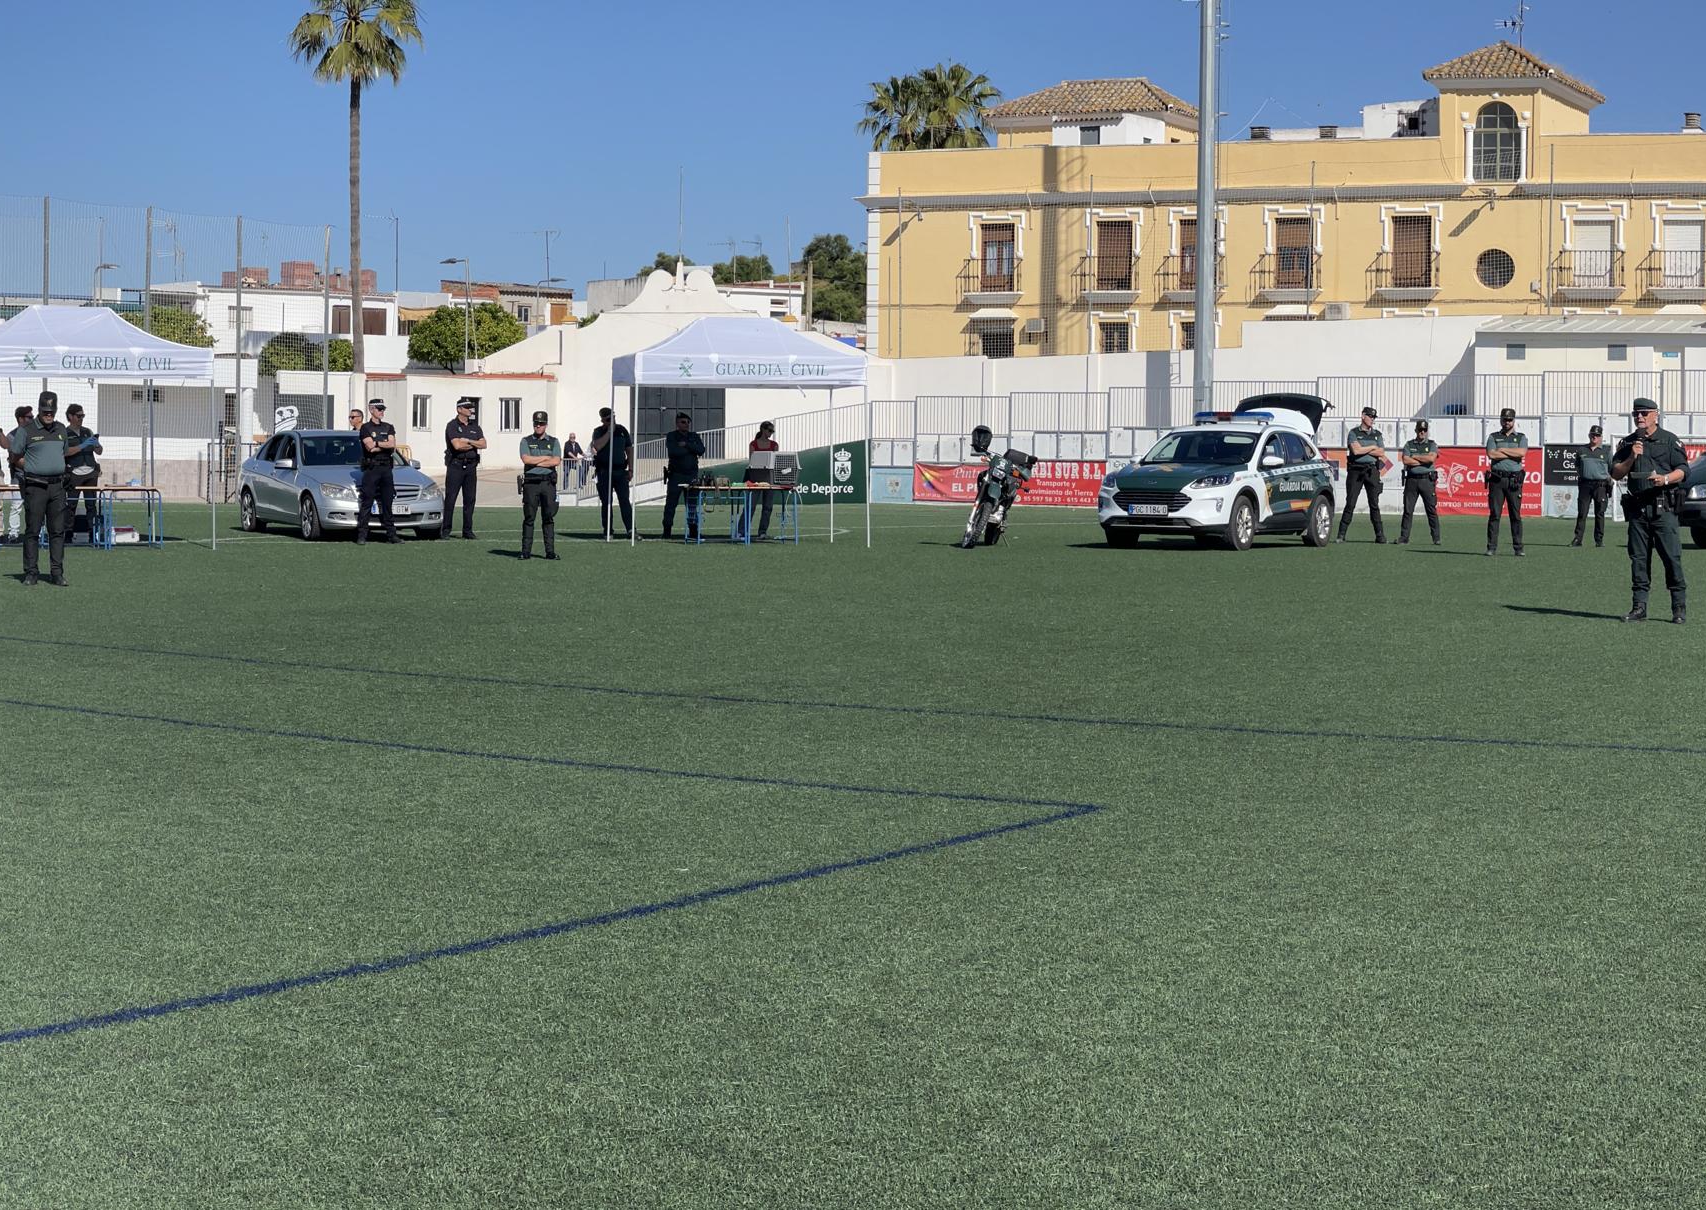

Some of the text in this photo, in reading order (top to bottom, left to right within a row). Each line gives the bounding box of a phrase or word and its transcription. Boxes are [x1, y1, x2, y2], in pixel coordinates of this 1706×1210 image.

[61, 355, 175, 371] GUARDIA CIVIL
[715, 363, 829, 376] GUARDIA CIVIL
[1055, 462, 1079, 479] SUR
[952, 483, 964, 492] EL
[1025, 488, 1062, 496] ovimiento
